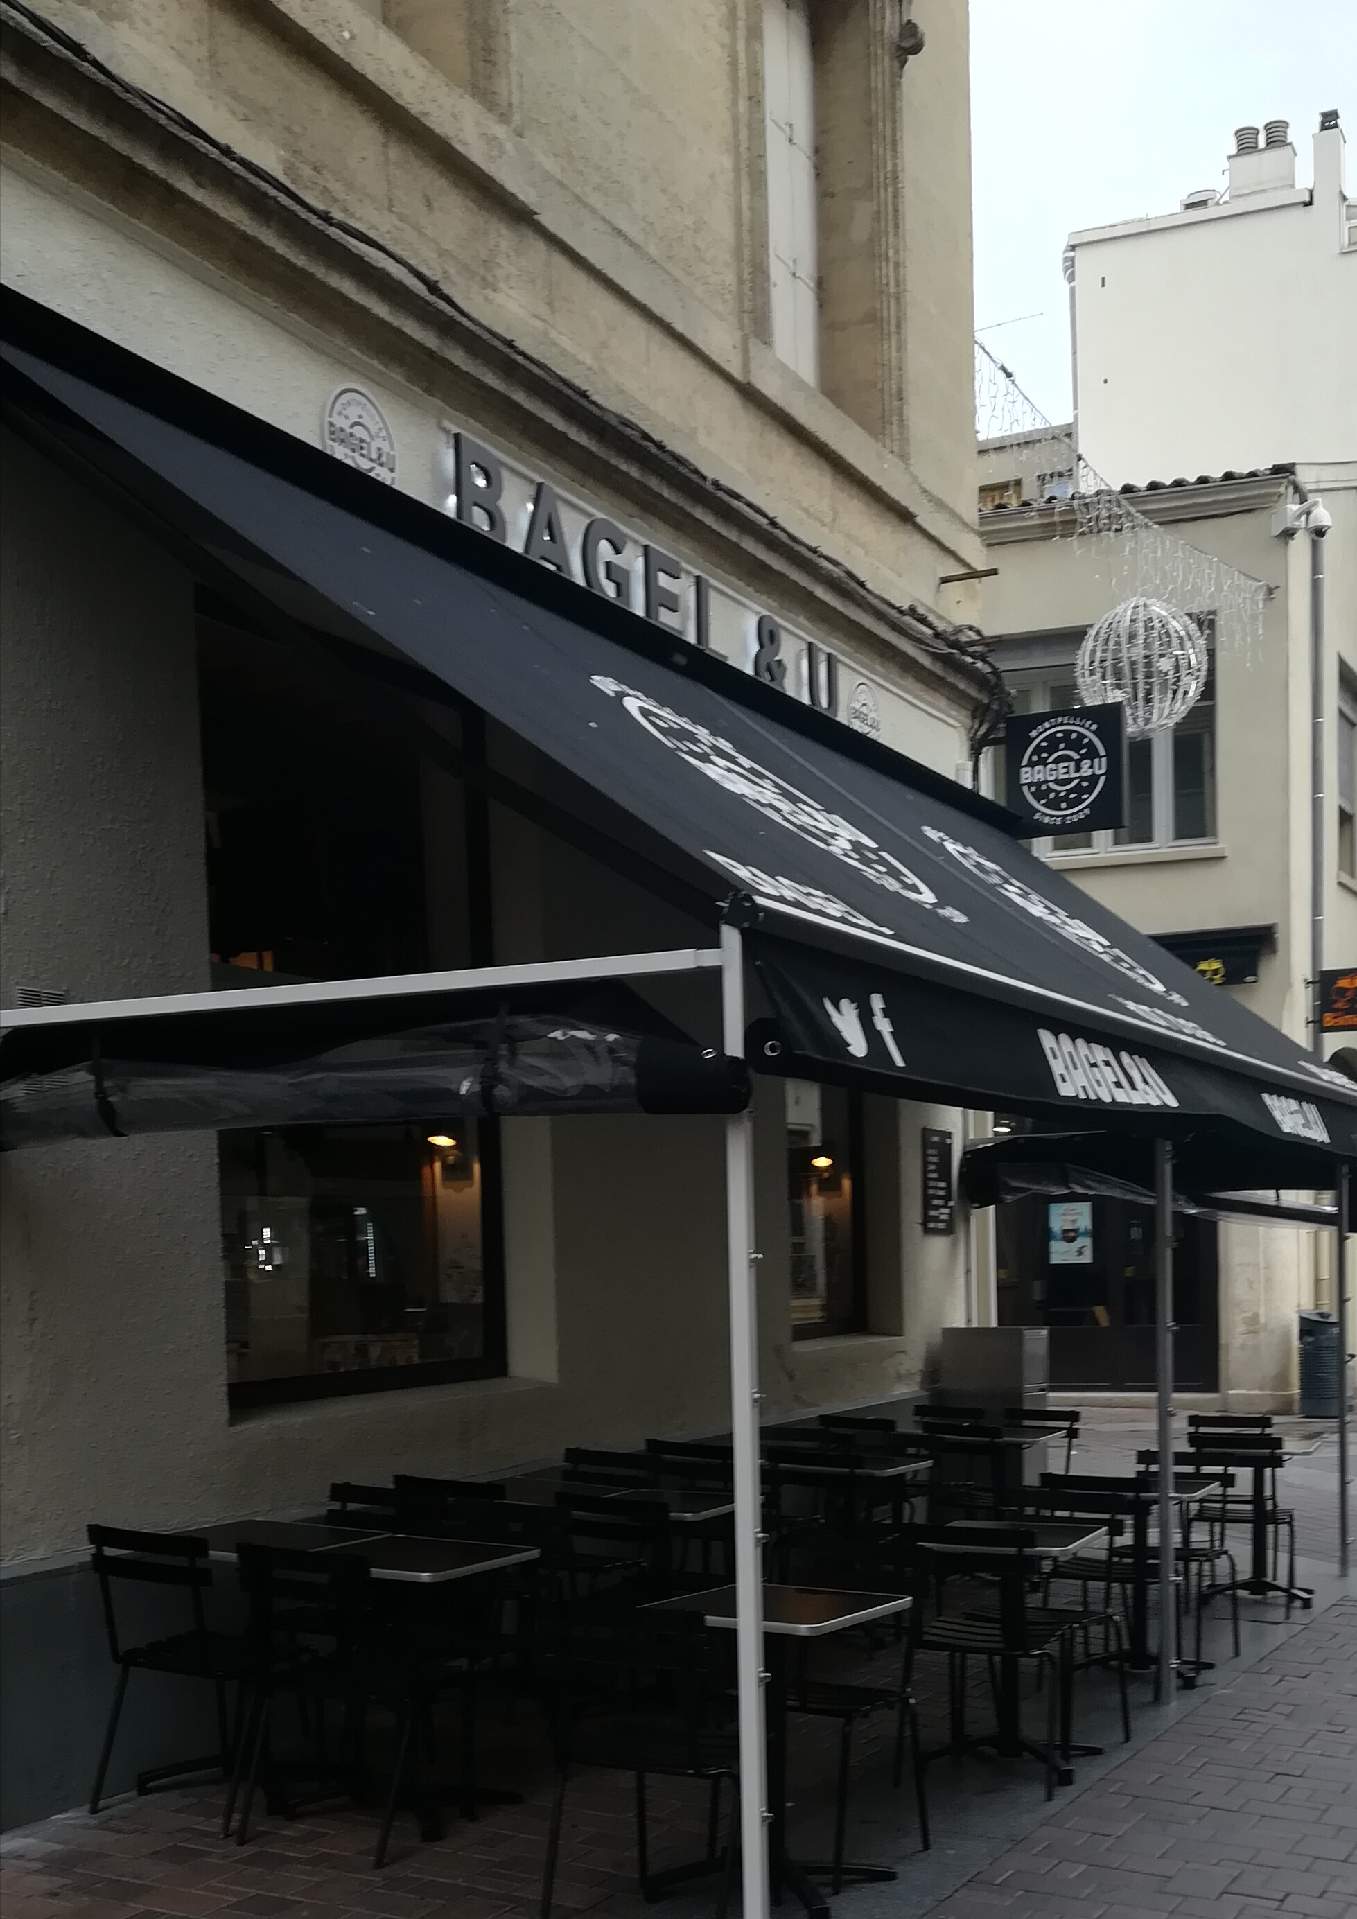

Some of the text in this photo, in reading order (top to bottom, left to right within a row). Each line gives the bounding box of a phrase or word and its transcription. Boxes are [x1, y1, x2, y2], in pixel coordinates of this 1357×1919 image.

[454, 432, 839, 719] BAGEL & U
[1019, 756, 1108, 785] BAGEL&U
